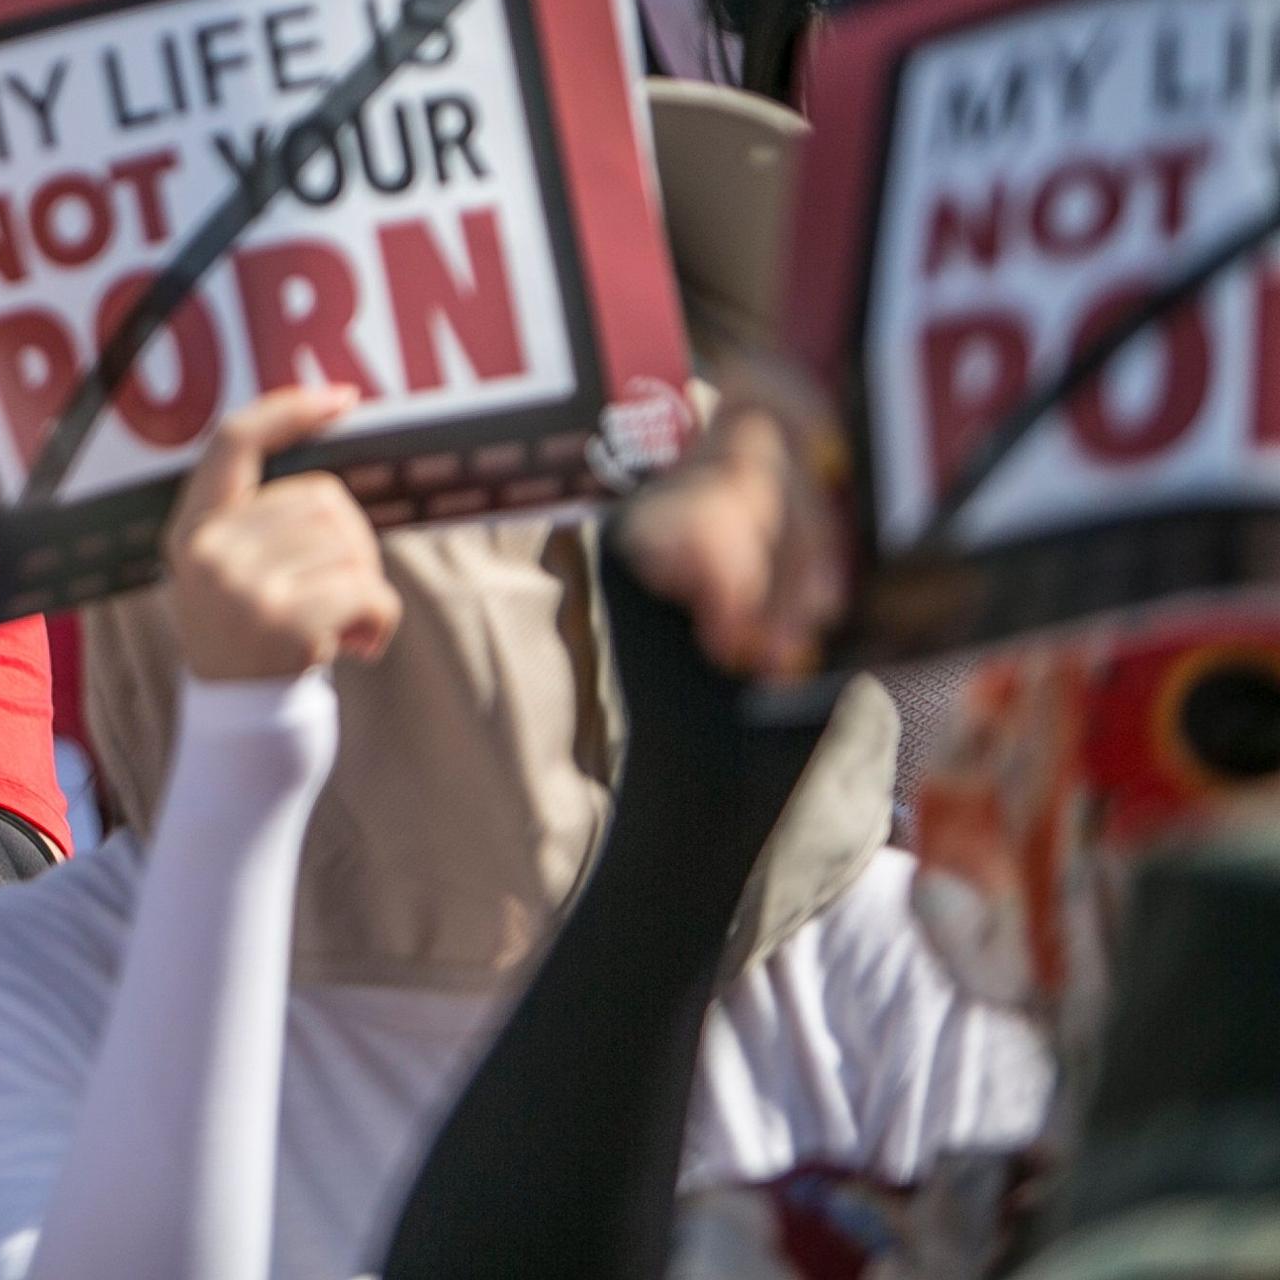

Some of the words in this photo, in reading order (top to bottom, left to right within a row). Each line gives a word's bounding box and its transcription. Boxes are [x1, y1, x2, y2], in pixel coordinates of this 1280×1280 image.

[95, 1, 328, 133] LIFE
[941, 14, 1115, 147] MY
[214, 91, 491, 207] YOUR
[922, 133, 1218, 280] NOT
